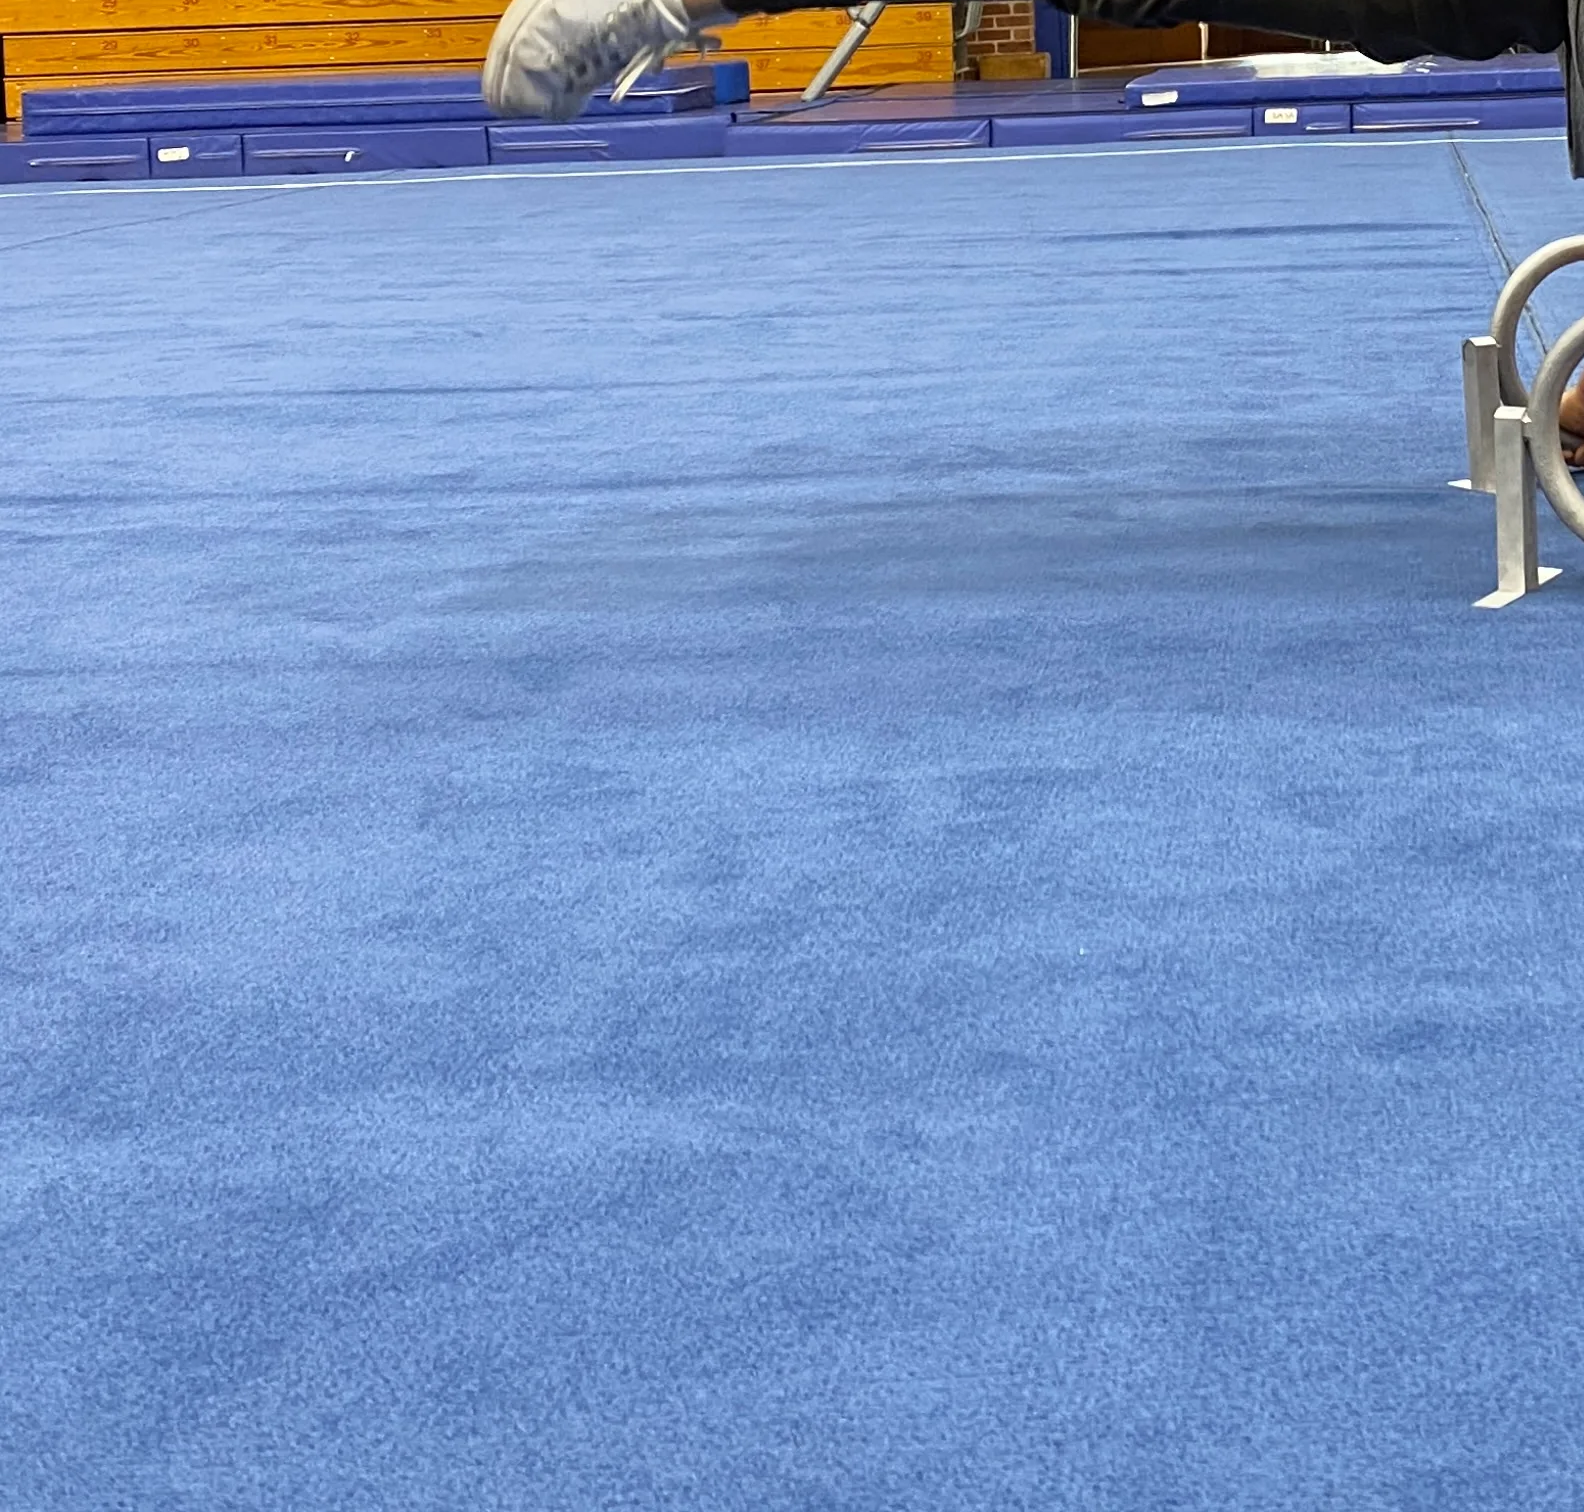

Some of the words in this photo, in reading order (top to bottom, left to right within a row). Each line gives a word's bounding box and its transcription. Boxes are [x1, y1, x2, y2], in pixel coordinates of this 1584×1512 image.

[102, 40, 118, 51] 29
[184, 37, 199, 48] 30
[917, 51, 932, 62] 39
